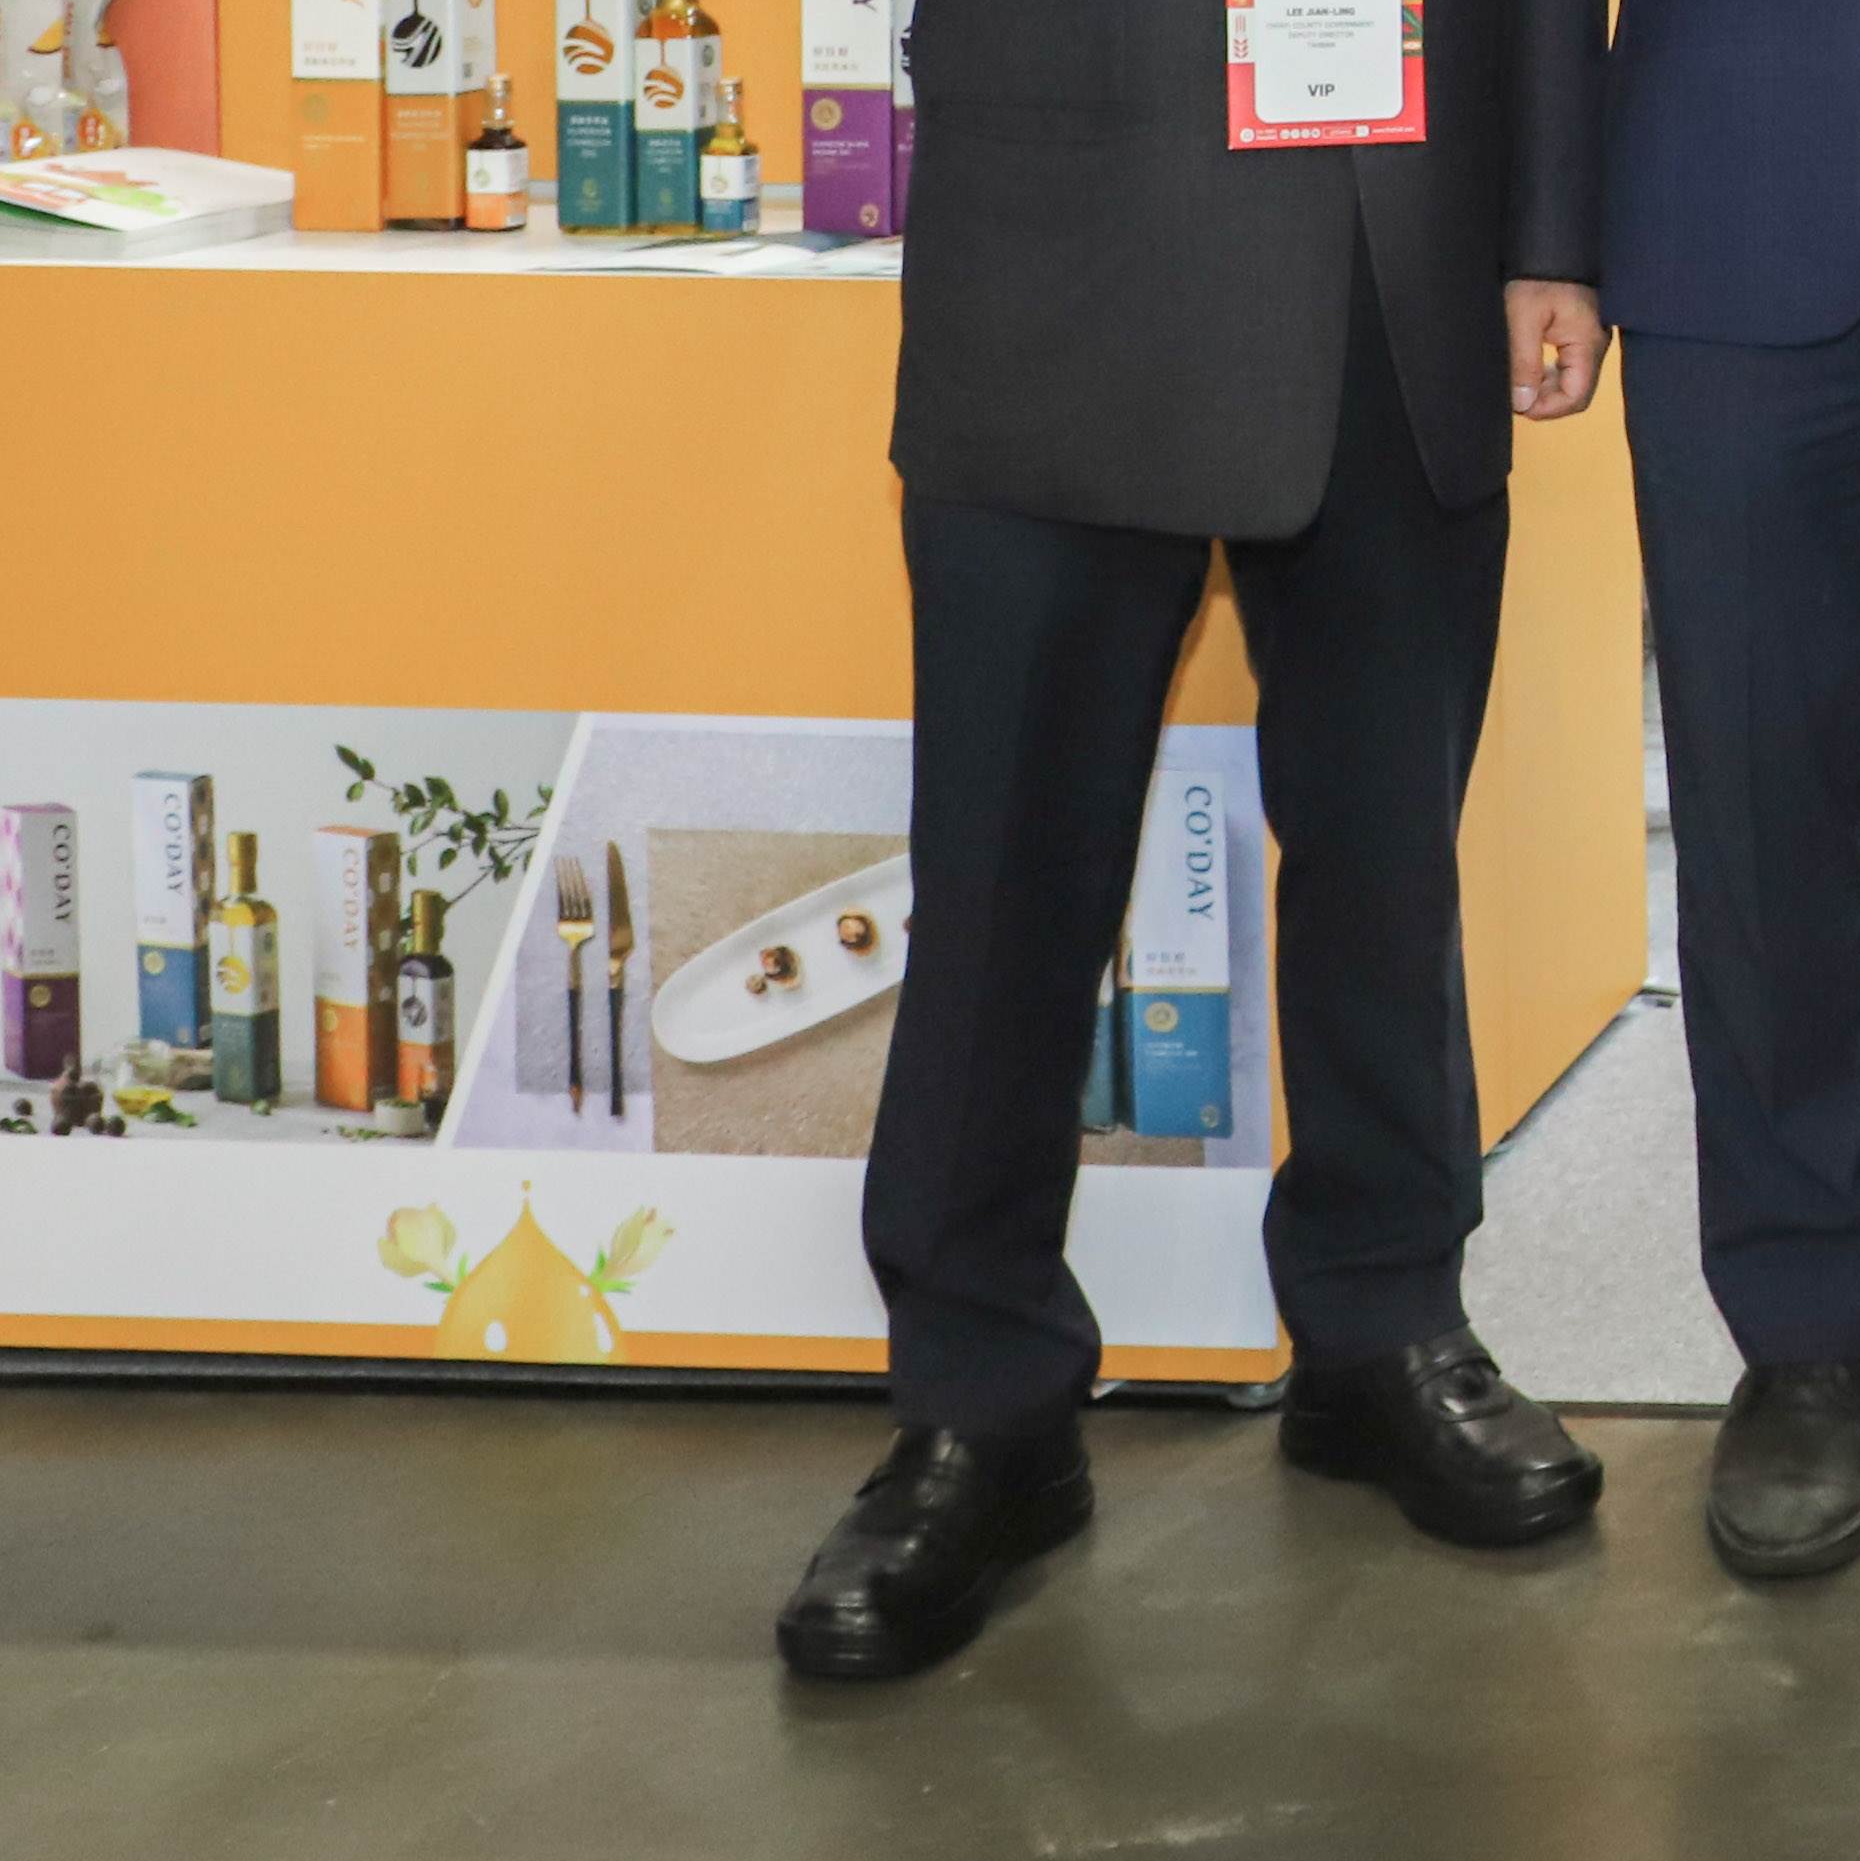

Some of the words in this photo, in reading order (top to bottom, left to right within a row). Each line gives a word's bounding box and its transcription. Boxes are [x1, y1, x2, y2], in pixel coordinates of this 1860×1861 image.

[1286, 7, 1304, 16] LEE
[1307, 83, 1336, 97] VIP
[52, 823, 72, 925] CO'DAY
[163, 792, 186, 897] CO'DAY
[1183, 784, 1215, 922] CO'DAY
[342, 846, 360, 951] CO'DAY
